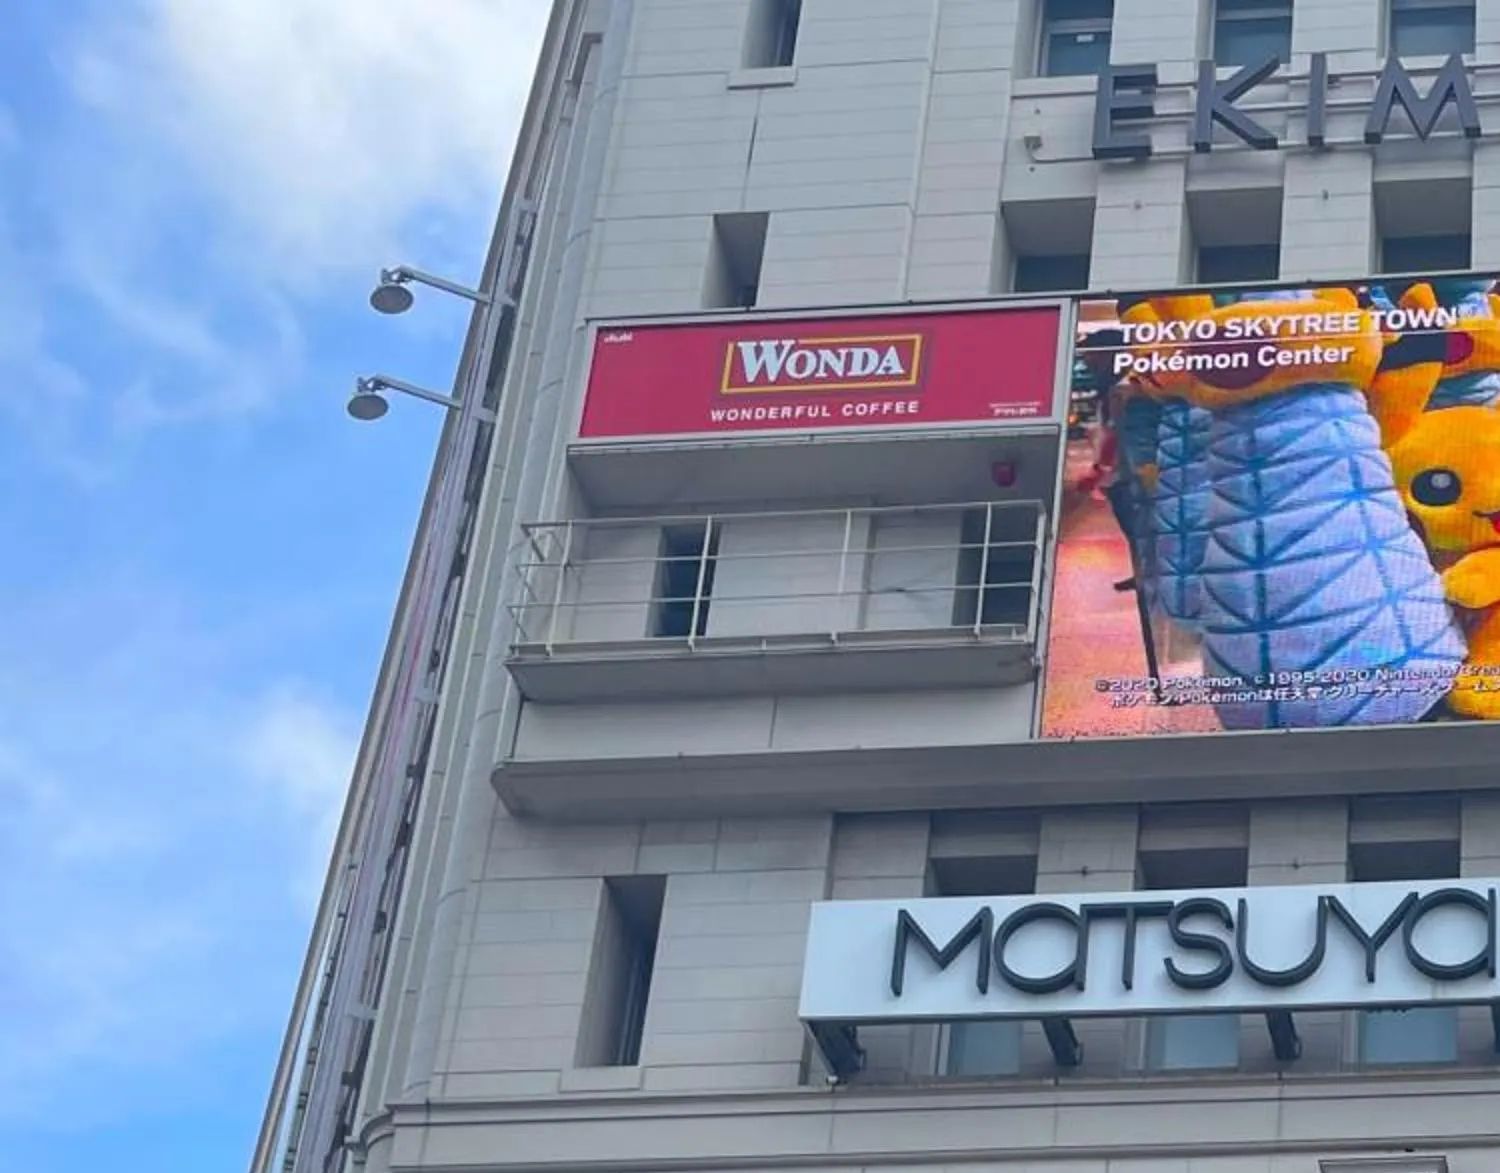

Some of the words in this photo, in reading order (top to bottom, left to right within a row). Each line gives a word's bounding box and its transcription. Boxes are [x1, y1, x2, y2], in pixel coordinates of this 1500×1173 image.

[1121, 321, 1216, 344] TOKYO
[1224, 313, 1361, 338] SKYTREE
[1370, 307, 1457, 331] TOWN
[738, 339, 905, 383] WONDA
[1113, 347, 1249, 375] Pokémon
[1257, 344, 1354, 367] Center
[710, 405, 831, 422] WONDERFUL
[842, 401, 920, 417] COFFEE
